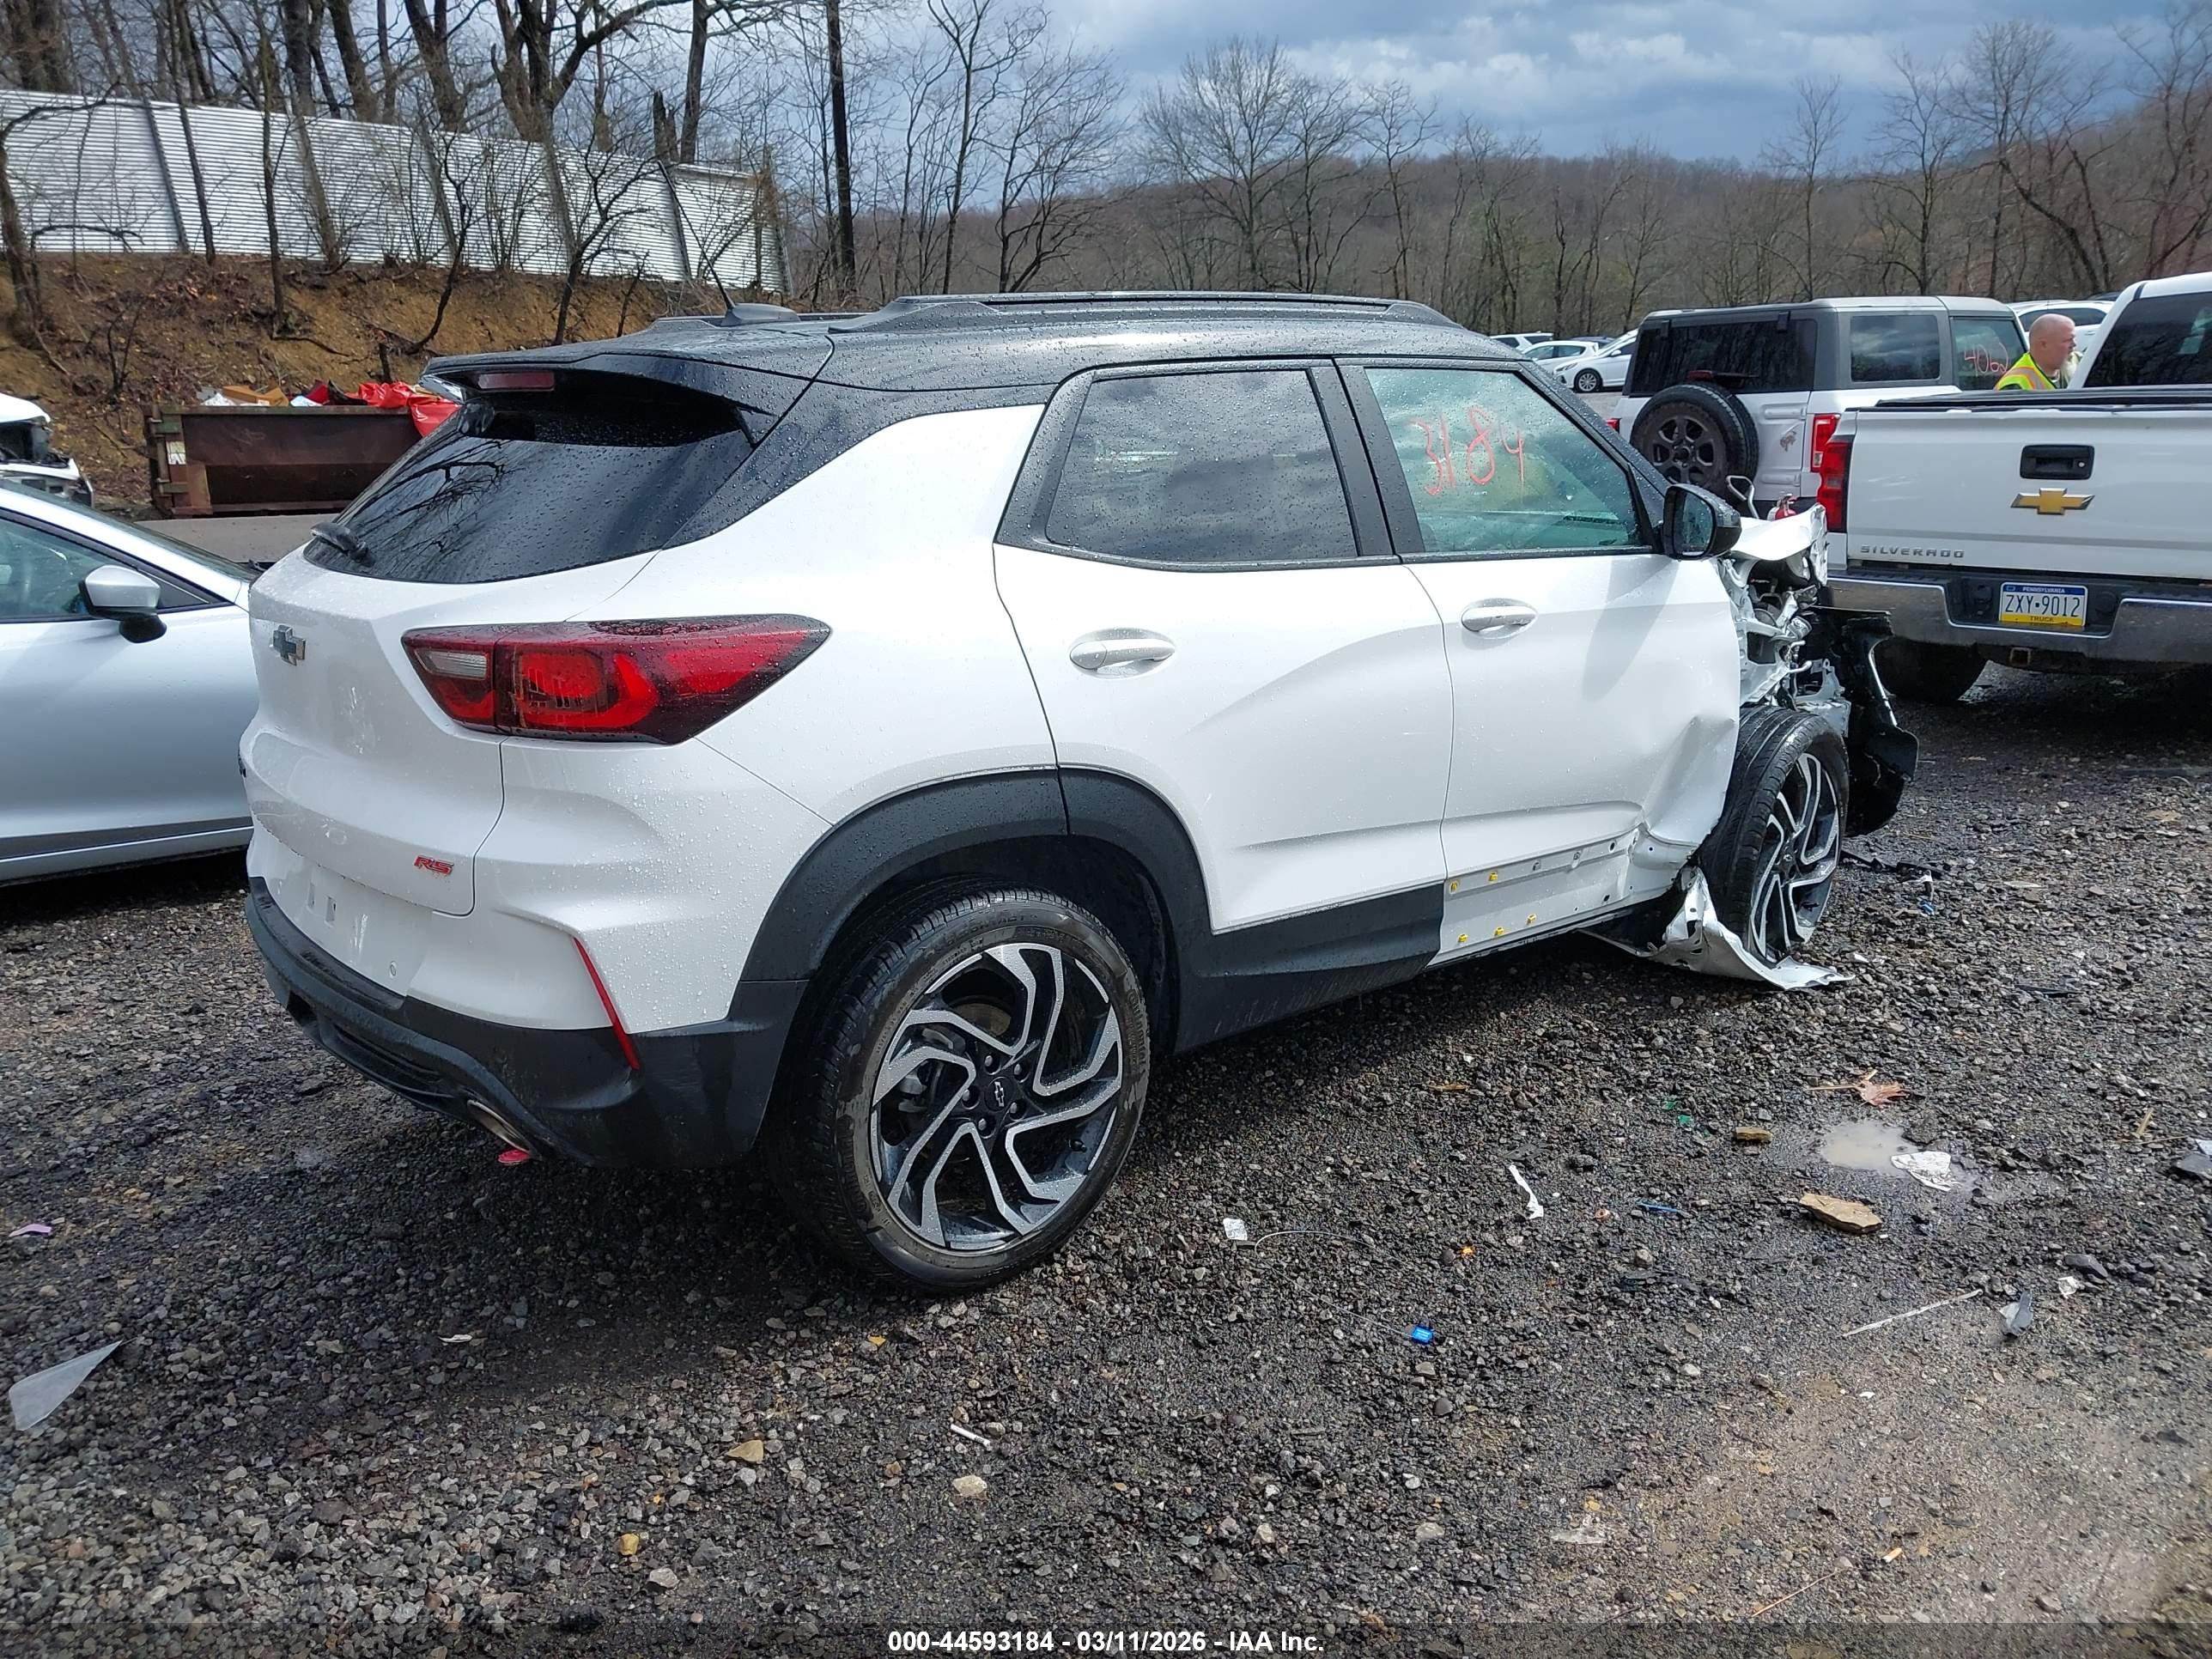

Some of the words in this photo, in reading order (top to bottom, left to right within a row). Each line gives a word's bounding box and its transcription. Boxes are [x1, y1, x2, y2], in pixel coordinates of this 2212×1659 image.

[1408, 404, 1526, 500] 3184
[1860, 544, 1965, 558] SILVERADO
[413, 855, 454, 876] RS
